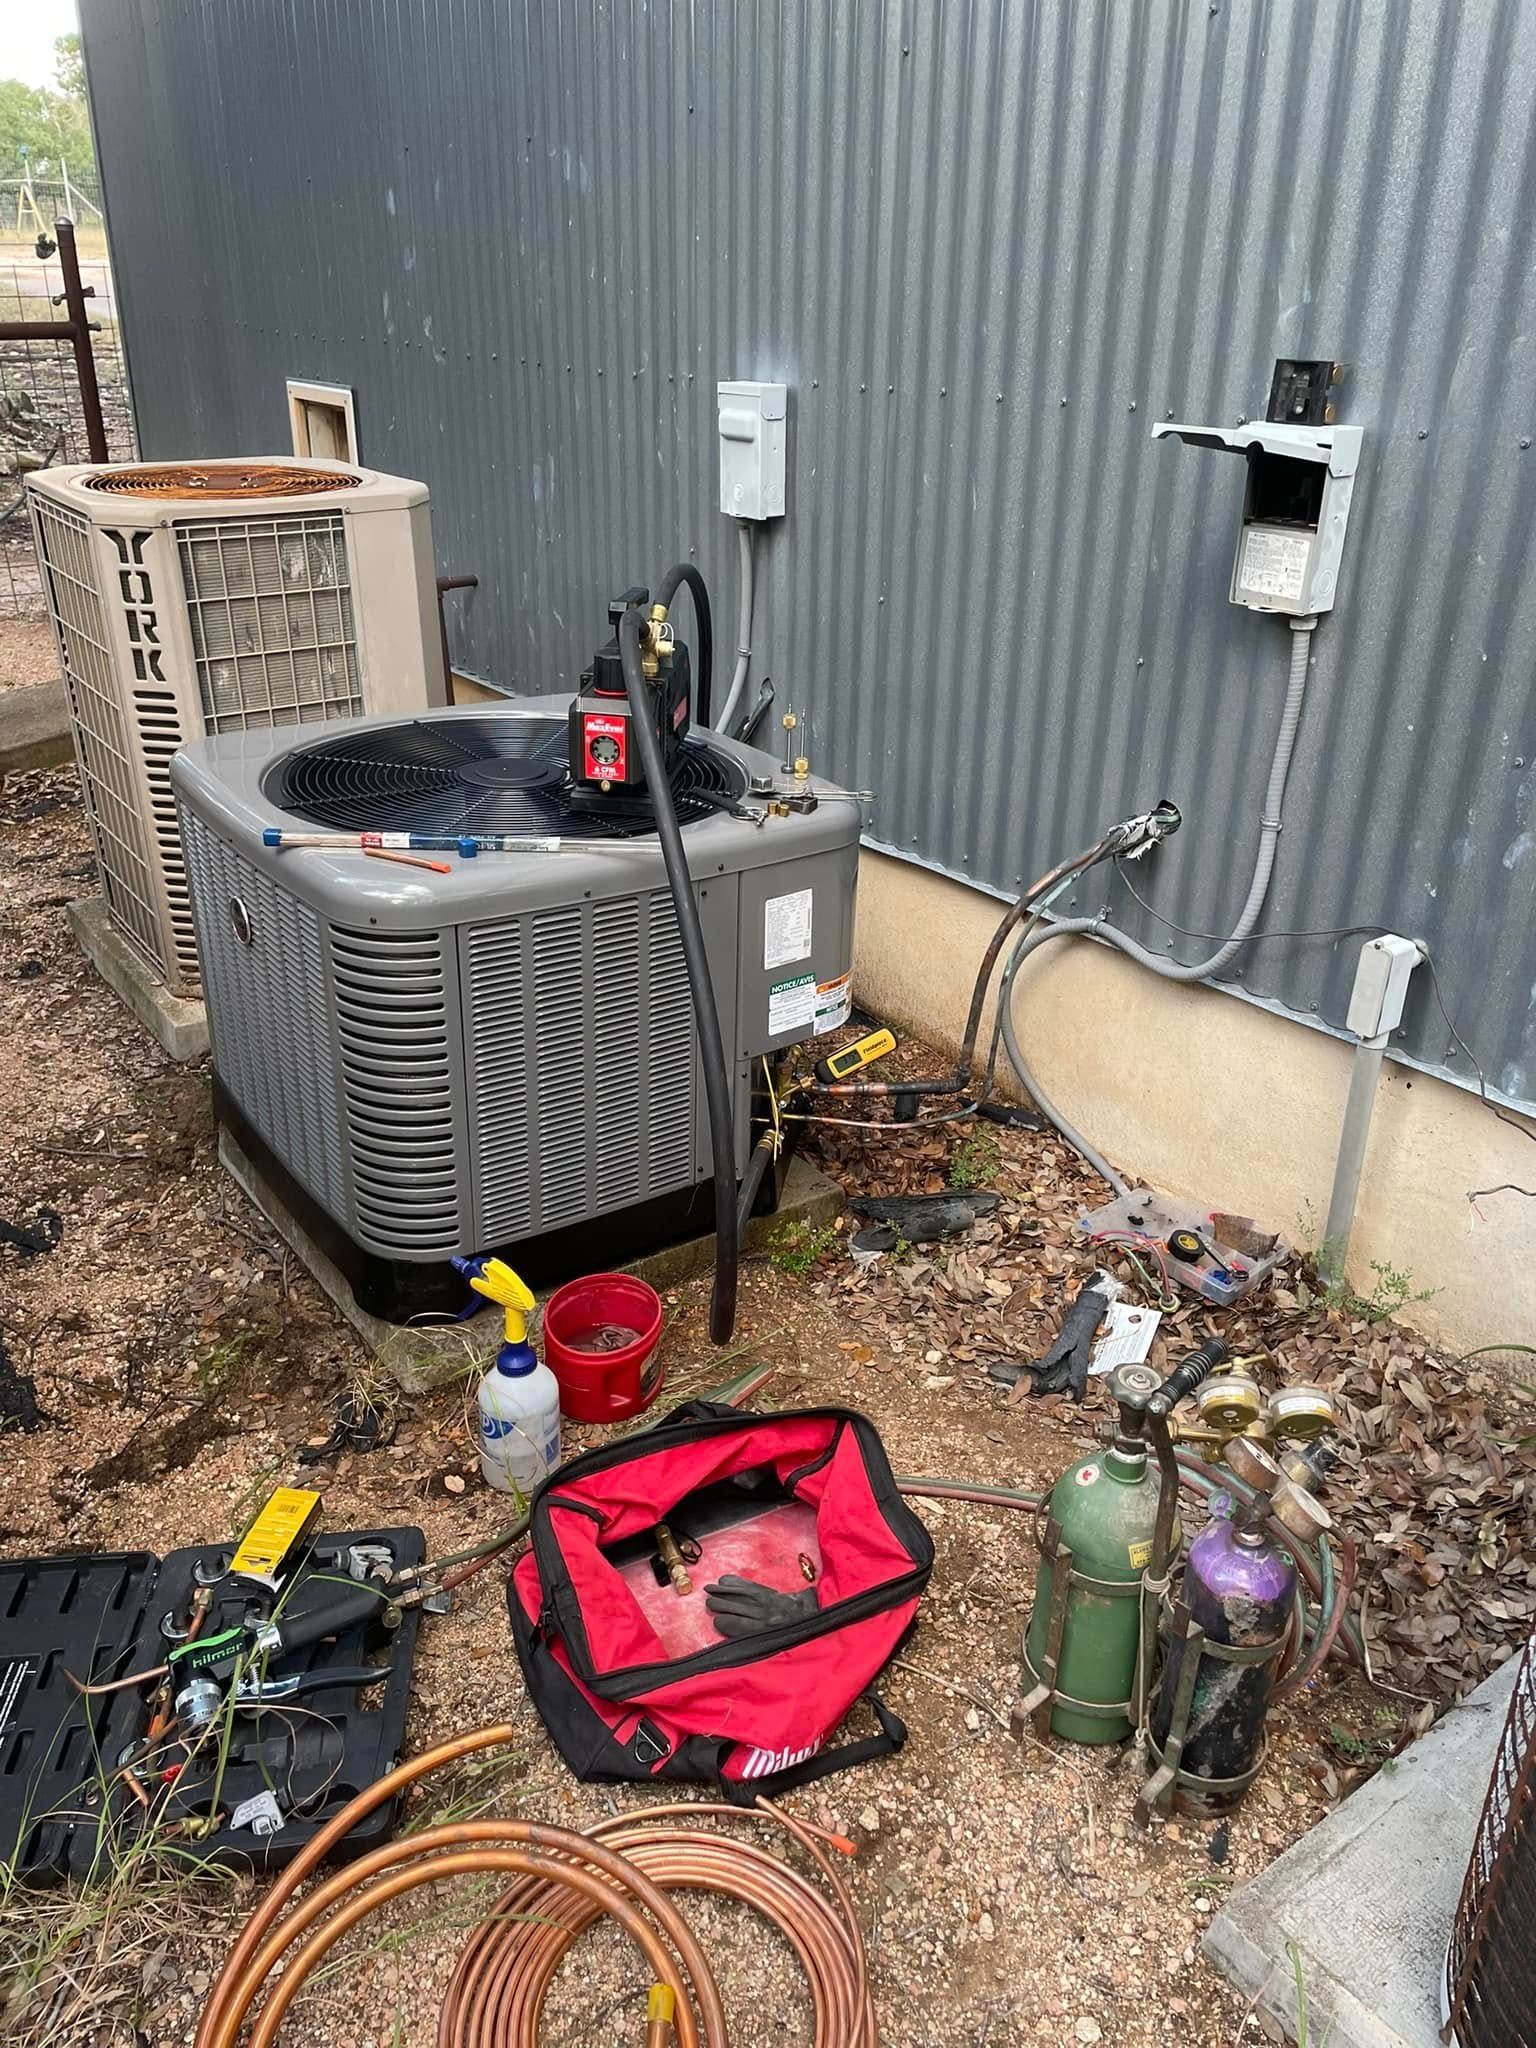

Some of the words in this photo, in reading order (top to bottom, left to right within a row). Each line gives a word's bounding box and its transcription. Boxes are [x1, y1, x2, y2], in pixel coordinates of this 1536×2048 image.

[100, 529, 167, 682] YORK
[771, 974, 815, 994] NOTICE/AVIS
[192, 1642, 243, 1668] hilmor
